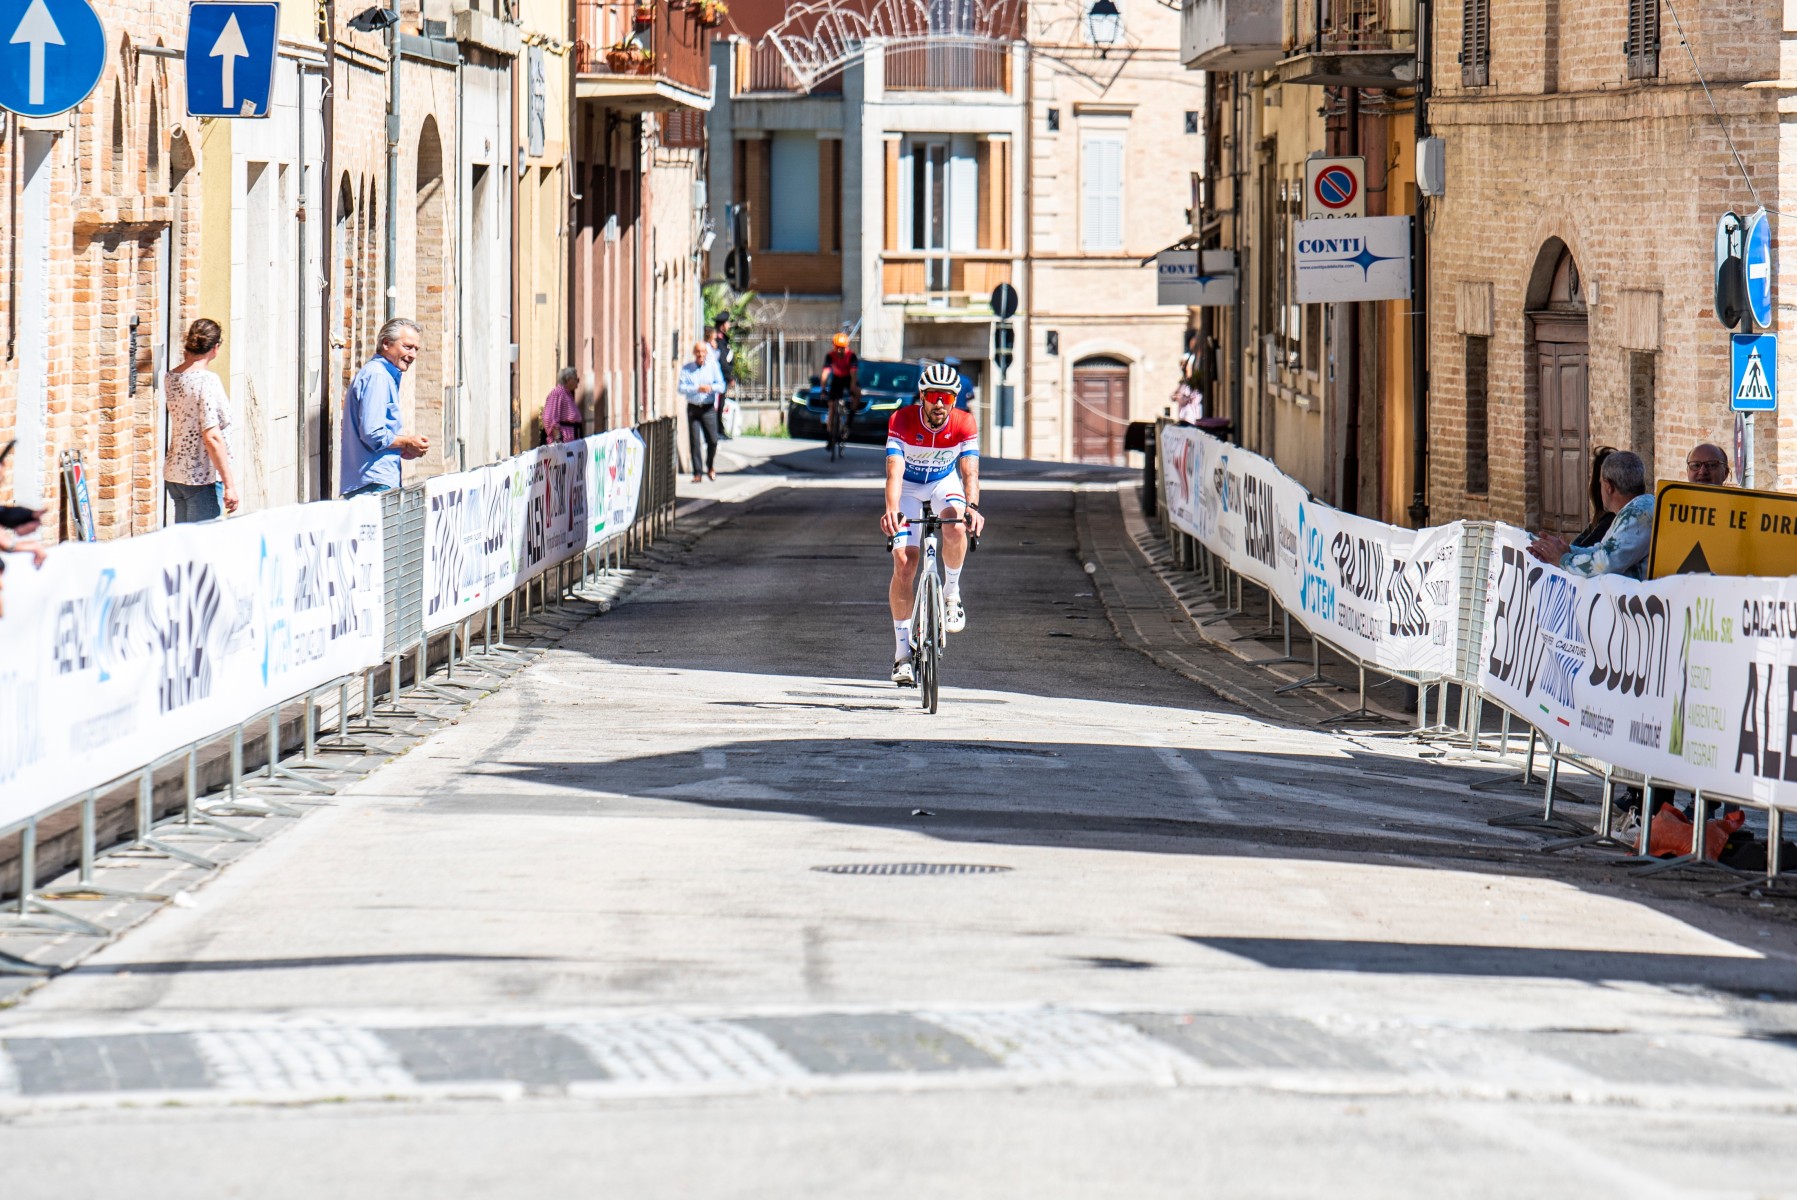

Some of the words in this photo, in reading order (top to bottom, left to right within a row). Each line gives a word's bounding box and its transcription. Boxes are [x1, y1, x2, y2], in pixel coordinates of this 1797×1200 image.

[1298, 238, 1360, 254] CONTI
[1159, 264, 1198, 274] CONT
[1669, 503, 1716, 526] TUTTE
[1729, 510, 1747, 530] LE
